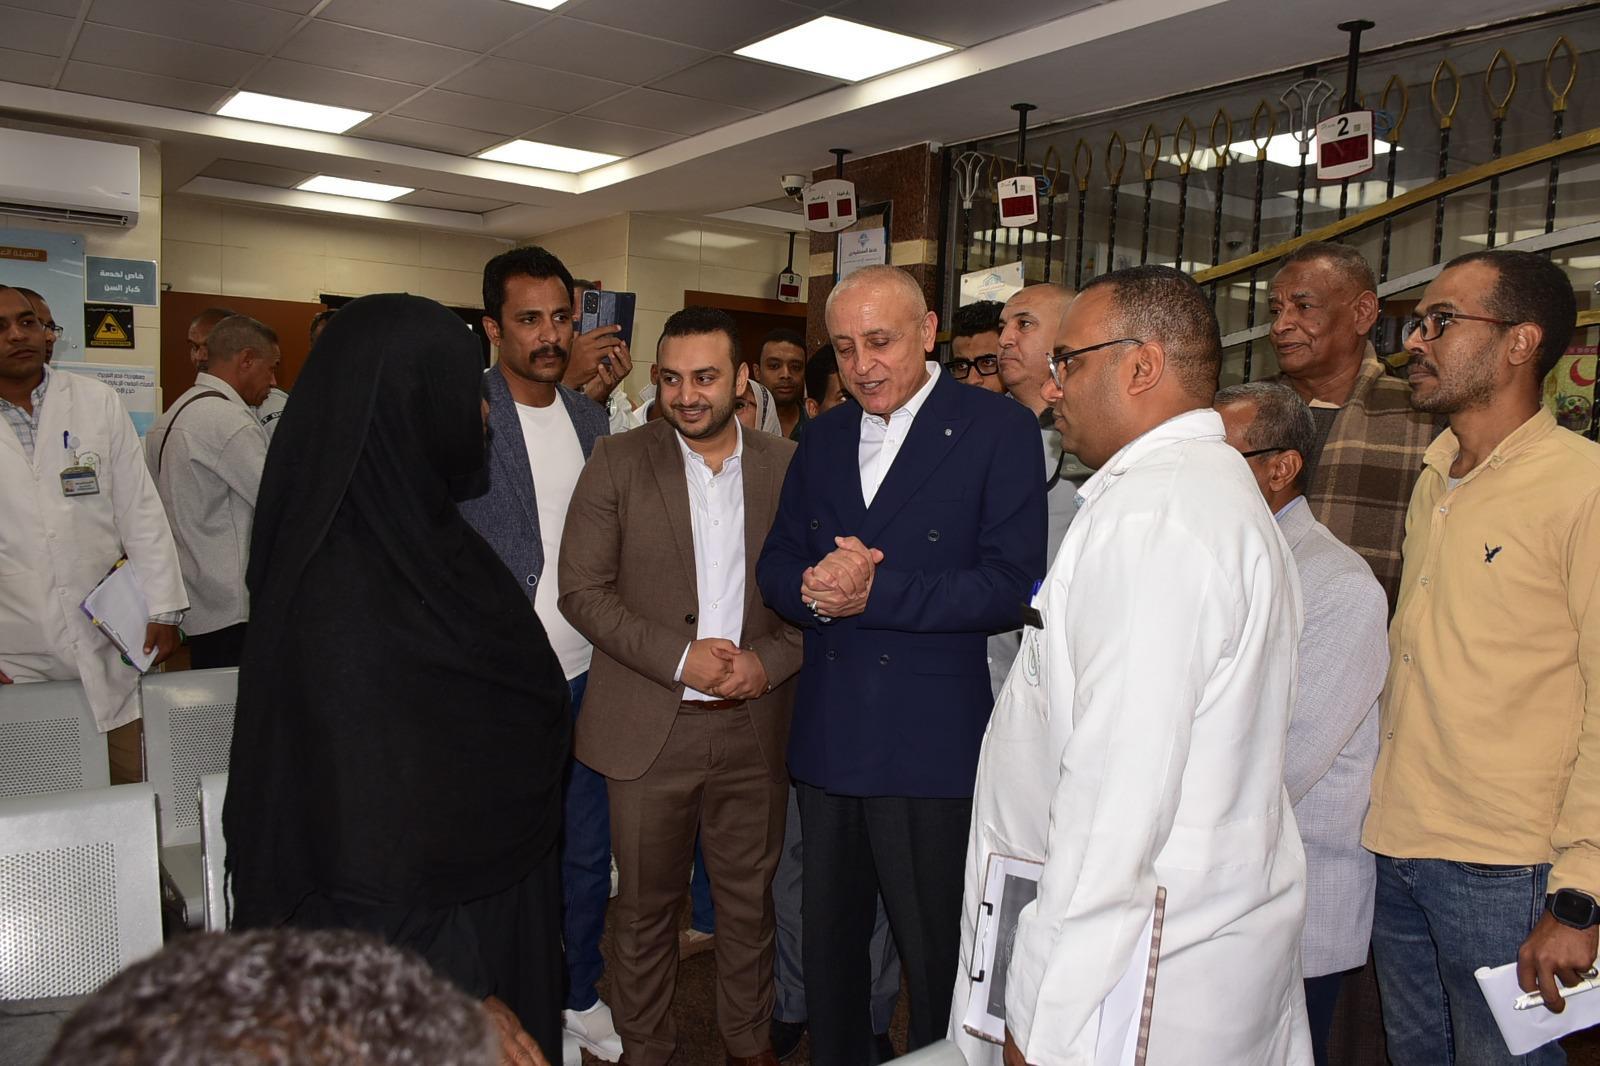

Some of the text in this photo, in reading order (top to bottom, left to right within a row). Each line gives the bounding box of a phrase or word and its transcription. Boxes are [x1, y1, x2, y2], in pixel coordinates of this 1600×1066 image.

[1337, 117, 1349, 137] 2
[1011, 179, 1018, 194] 1
[104, 283, 123, 292] السن
